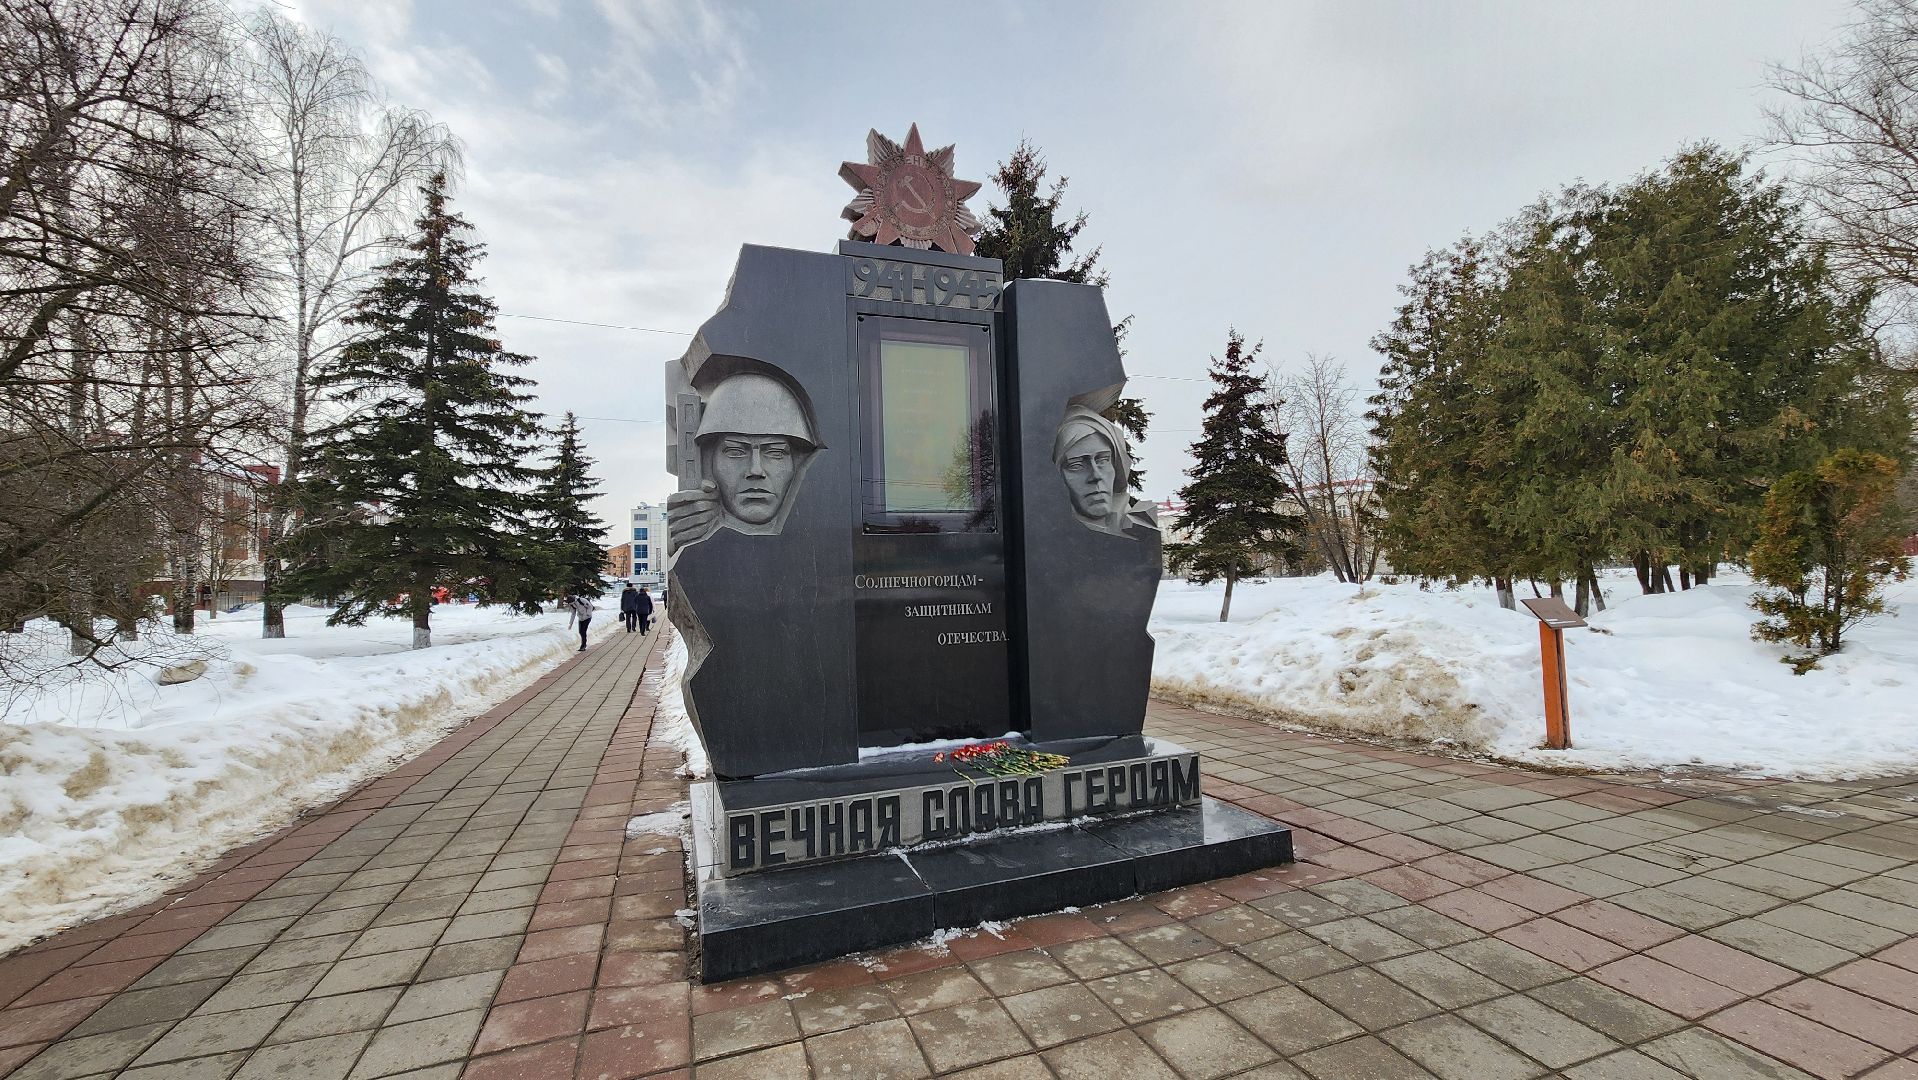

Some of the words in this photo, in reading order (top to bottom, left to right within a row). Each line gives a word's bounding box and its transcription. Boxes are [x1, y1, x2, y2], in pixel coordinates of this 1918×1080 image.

[904, 602, 992, 618] ЗАЩИТНИКАМ
[729, 795, 900, 870] ВЕЧНАЯ
[922, 777, 1044, 838] СЛАВА
[1063, 755, 1199, 816] ГЕРОЯМ
